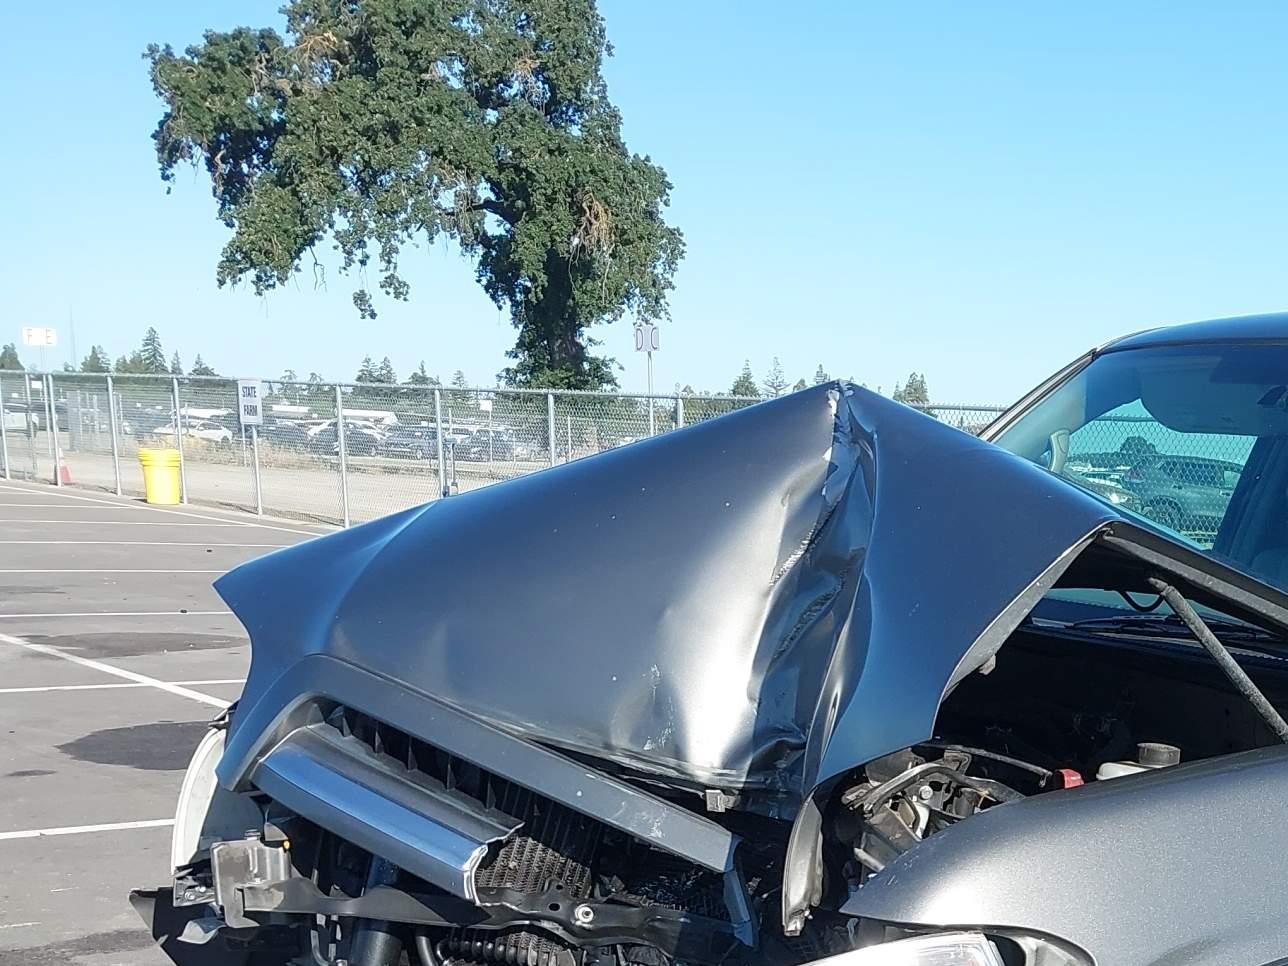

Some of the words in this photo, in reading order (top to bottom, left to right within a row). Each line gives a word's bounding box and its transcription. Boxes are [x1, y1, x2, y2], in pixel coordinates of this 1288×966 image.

[635, 328, 643, 350] D
[650, 327, 658, 350] C
[241, 385, 257, 398] STATE
